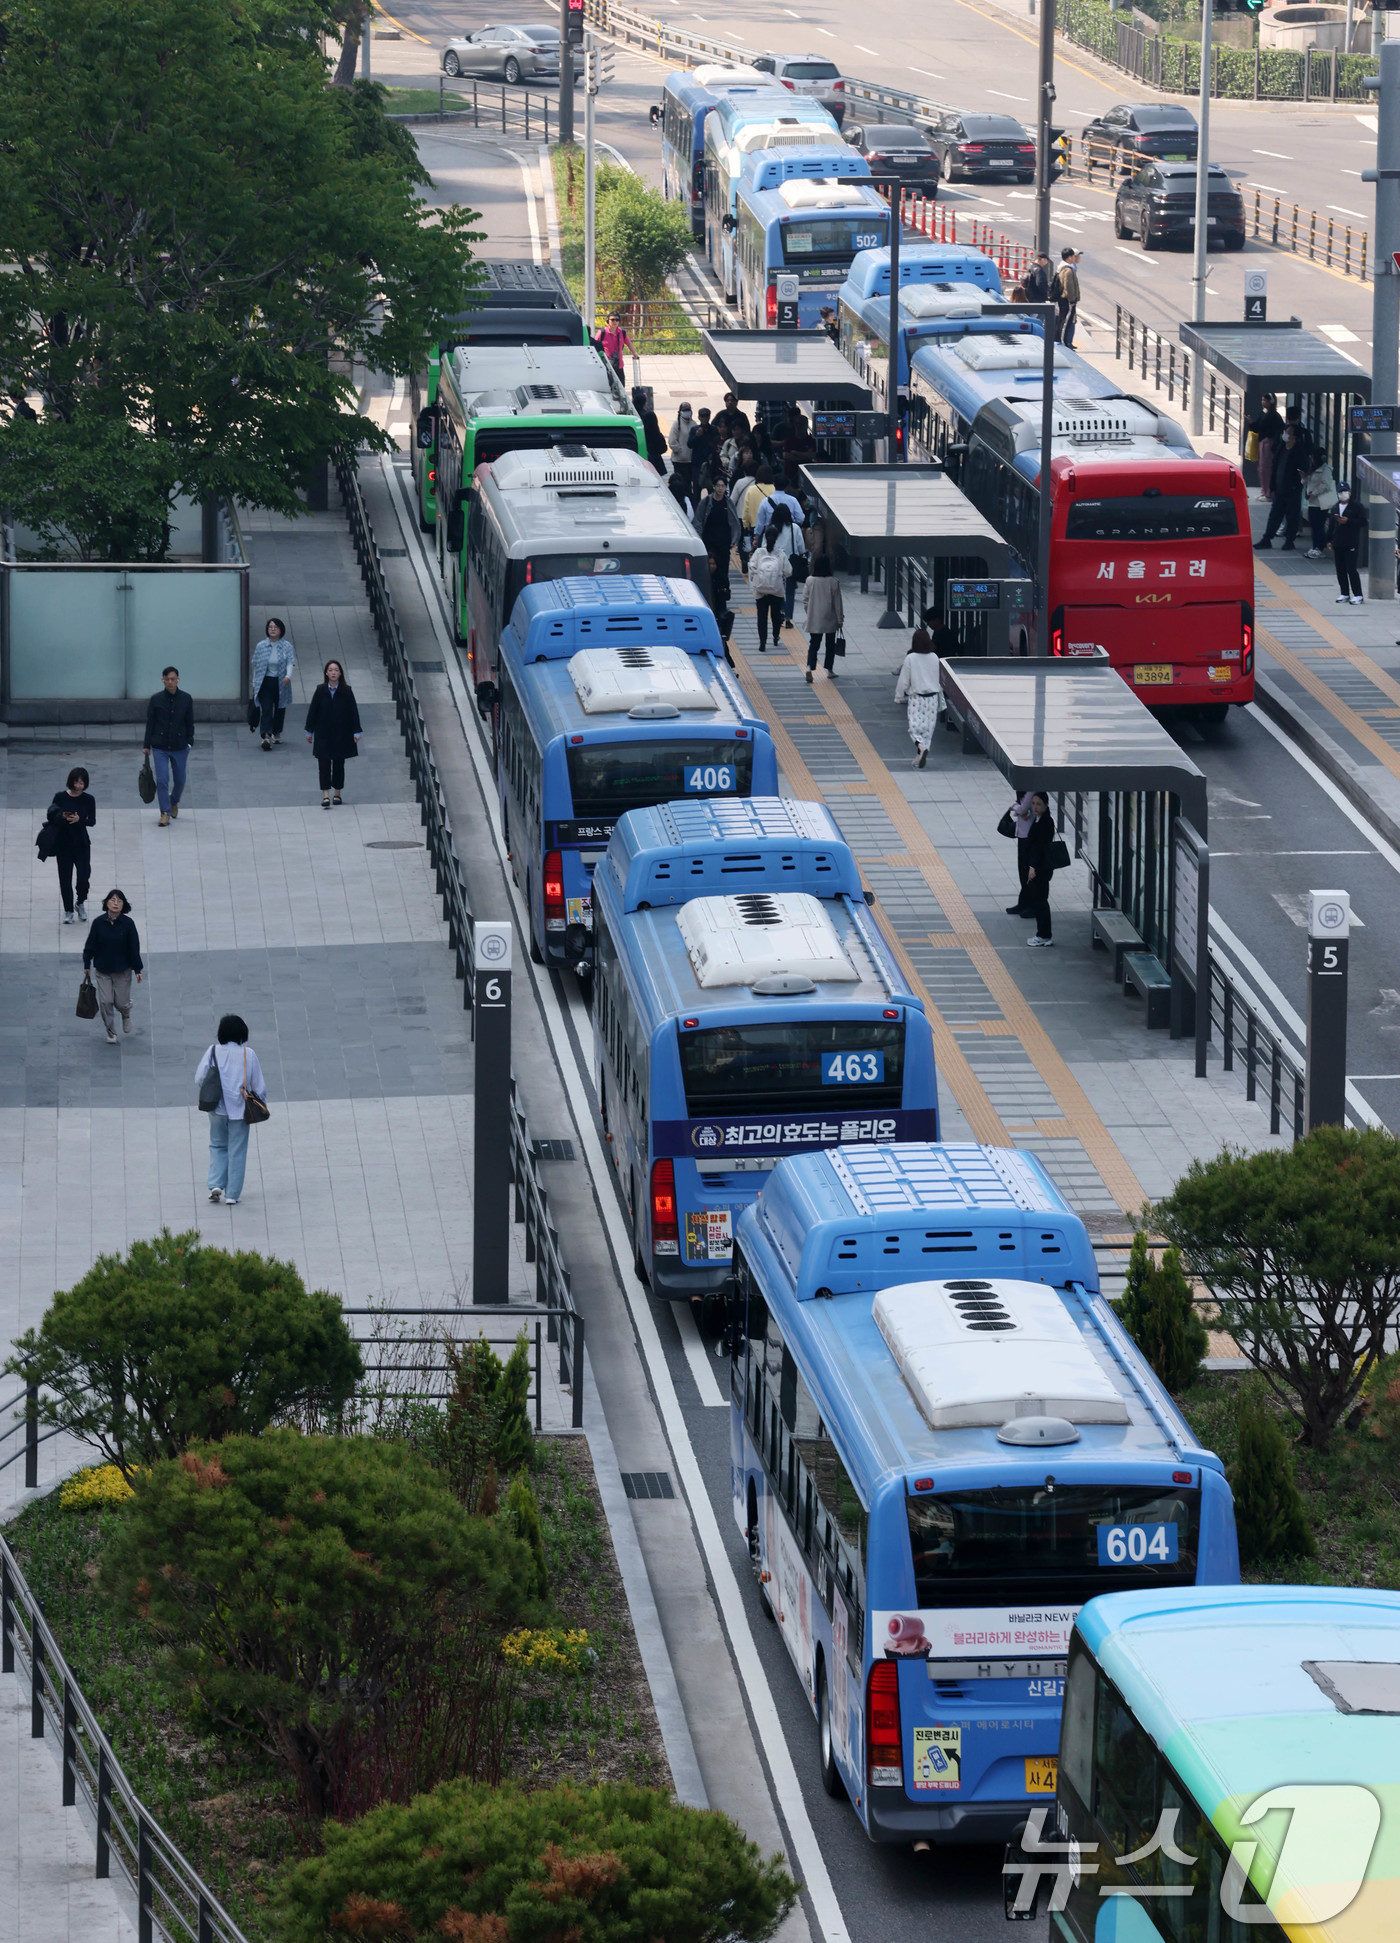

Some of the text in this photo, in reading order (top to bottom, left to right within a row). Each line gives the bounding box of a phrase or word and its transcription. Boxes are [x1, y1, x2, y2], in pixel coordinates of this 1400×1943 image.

[856, 234, 878, 247] 502
[783, 306, 793, 319] 5
[1251, 300, 1262, 314] 4
[1096, 526, 1211, 535] GRANBIRD
[953, 585, 988, 593] 406 463
[1135, 593, 1172, 603] KIA
[1144, 671, 1170, 681] 3894
[690, 766, 731, 790] 406
[577, 826, 603, 837] 프랑스
[603, 826, 616, 836] 국
[1323, 946, 1338, 968] 5
[485, 978, 502, 1000] 6
[828, 1053, 878, 1081] 463
[840, 1118, 897, 1141] 풀리오
[699, 1136, 717, 1146] 대상
[1106, 1525, 1170, 1563] 604
[1008, 1613, 1043, 1623] 바닐라코
[1044, 1612, 1070, 1622] NEW
[953, 1629, 1011, 1645] 블러리하게
[1014, 1630, 1060, 1644] 완성하는
[976, 1719, 1035, 1731] 에어로시티
[915, 1730, 959, 1741] 진로변경시
